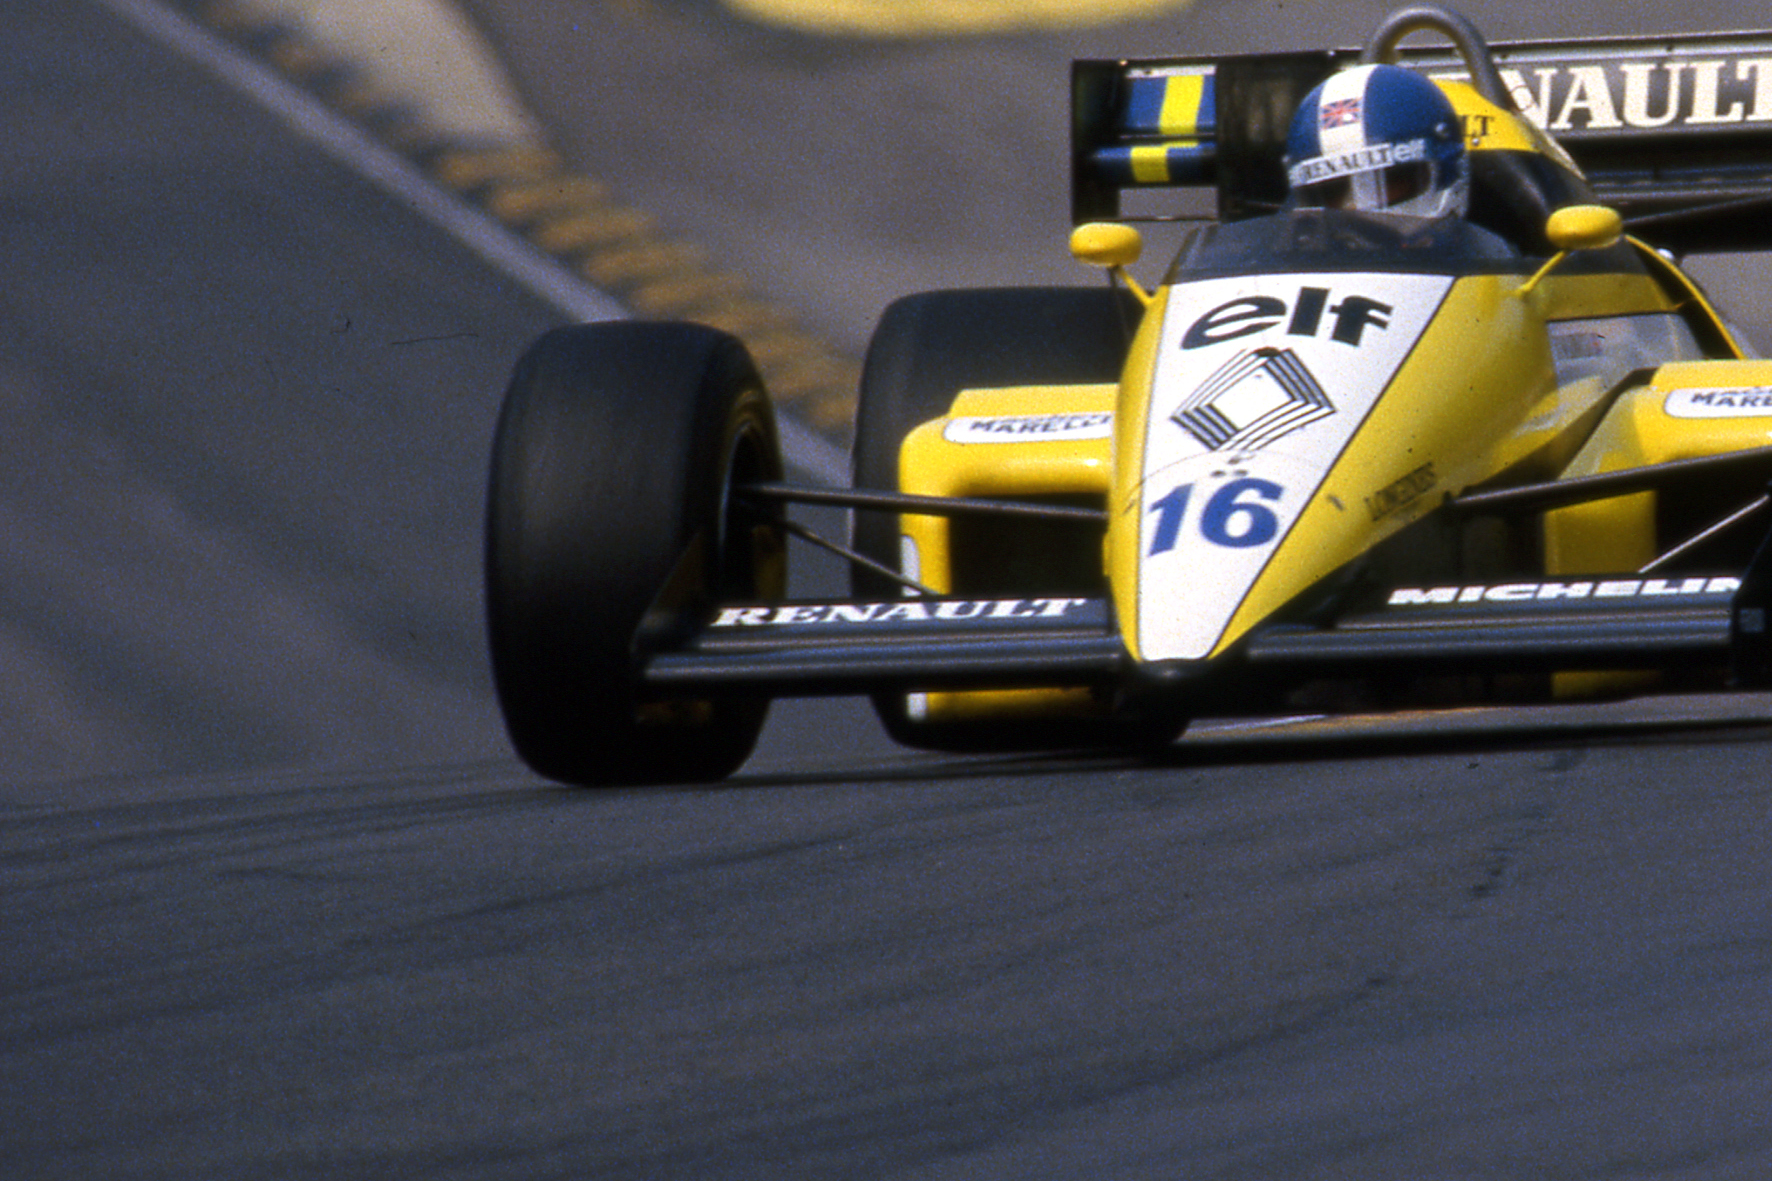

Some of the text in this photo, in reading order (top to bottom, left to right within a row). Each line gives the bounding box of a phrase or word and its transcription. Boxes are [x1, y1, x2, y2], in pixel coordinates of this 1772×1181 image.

[1180, 285, 1394, 351] elf
[1147, 476, 1286, 557] 16
[709, 597, 1089, 628] RENAULT
